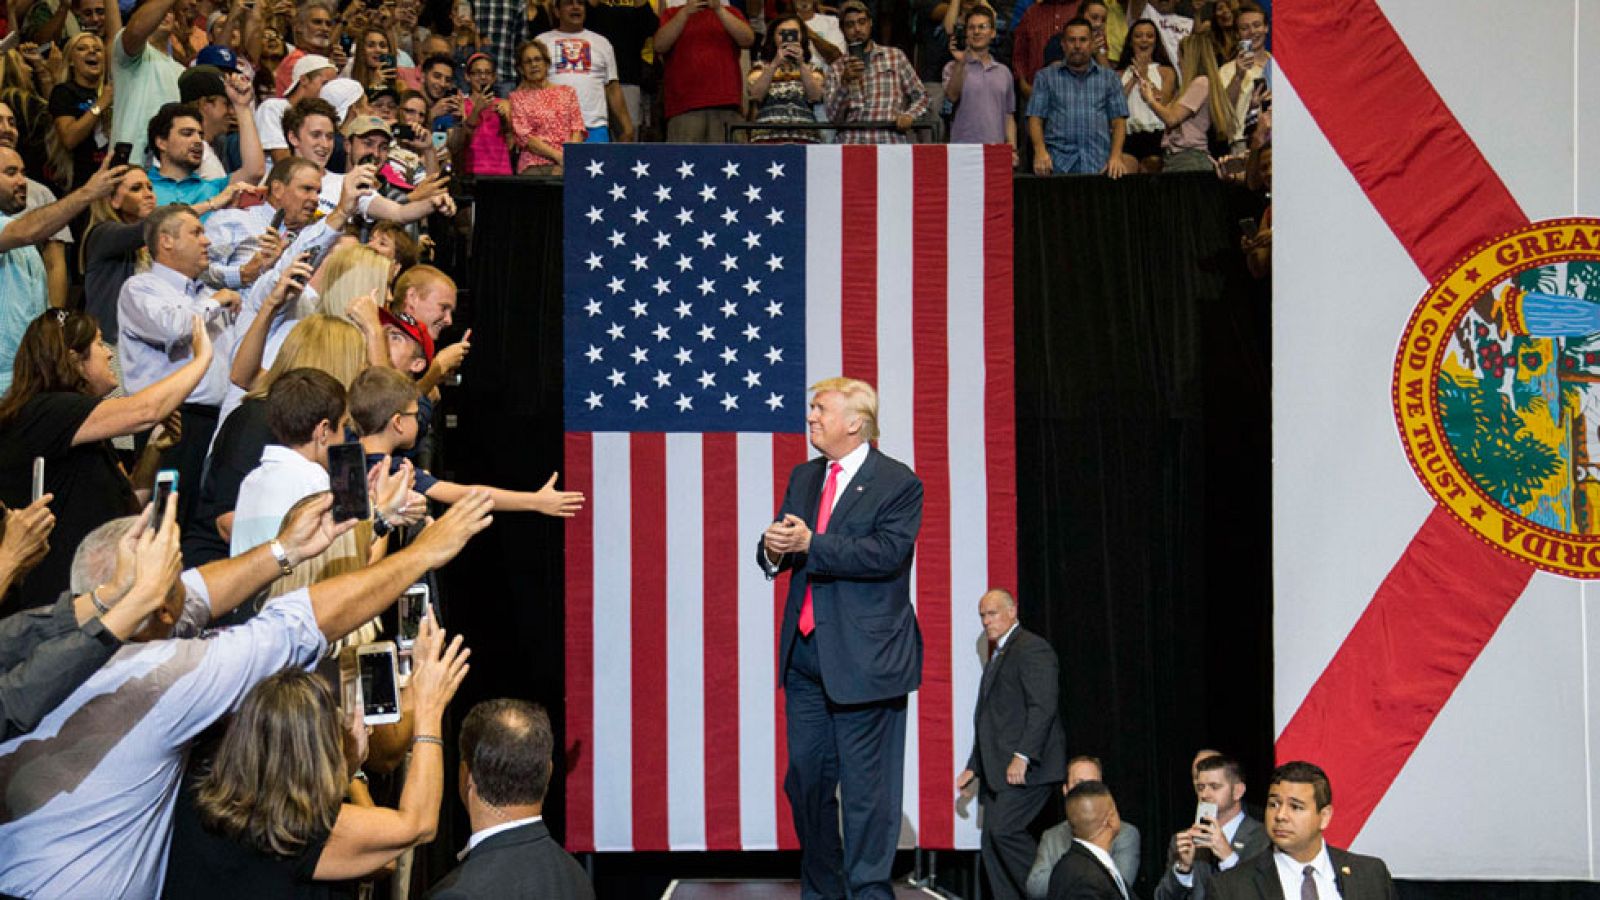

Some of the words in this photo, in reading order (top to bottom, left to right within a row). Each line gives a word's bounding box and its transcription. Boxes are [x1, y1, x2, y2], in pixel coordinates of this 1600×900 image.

[1432, 286, 1459, 316] IN
[1409, 318, 1437, 370] GOD
[1405, 378, 1425, 418] WE
[1413, 422, 1466, 499] TRUST
